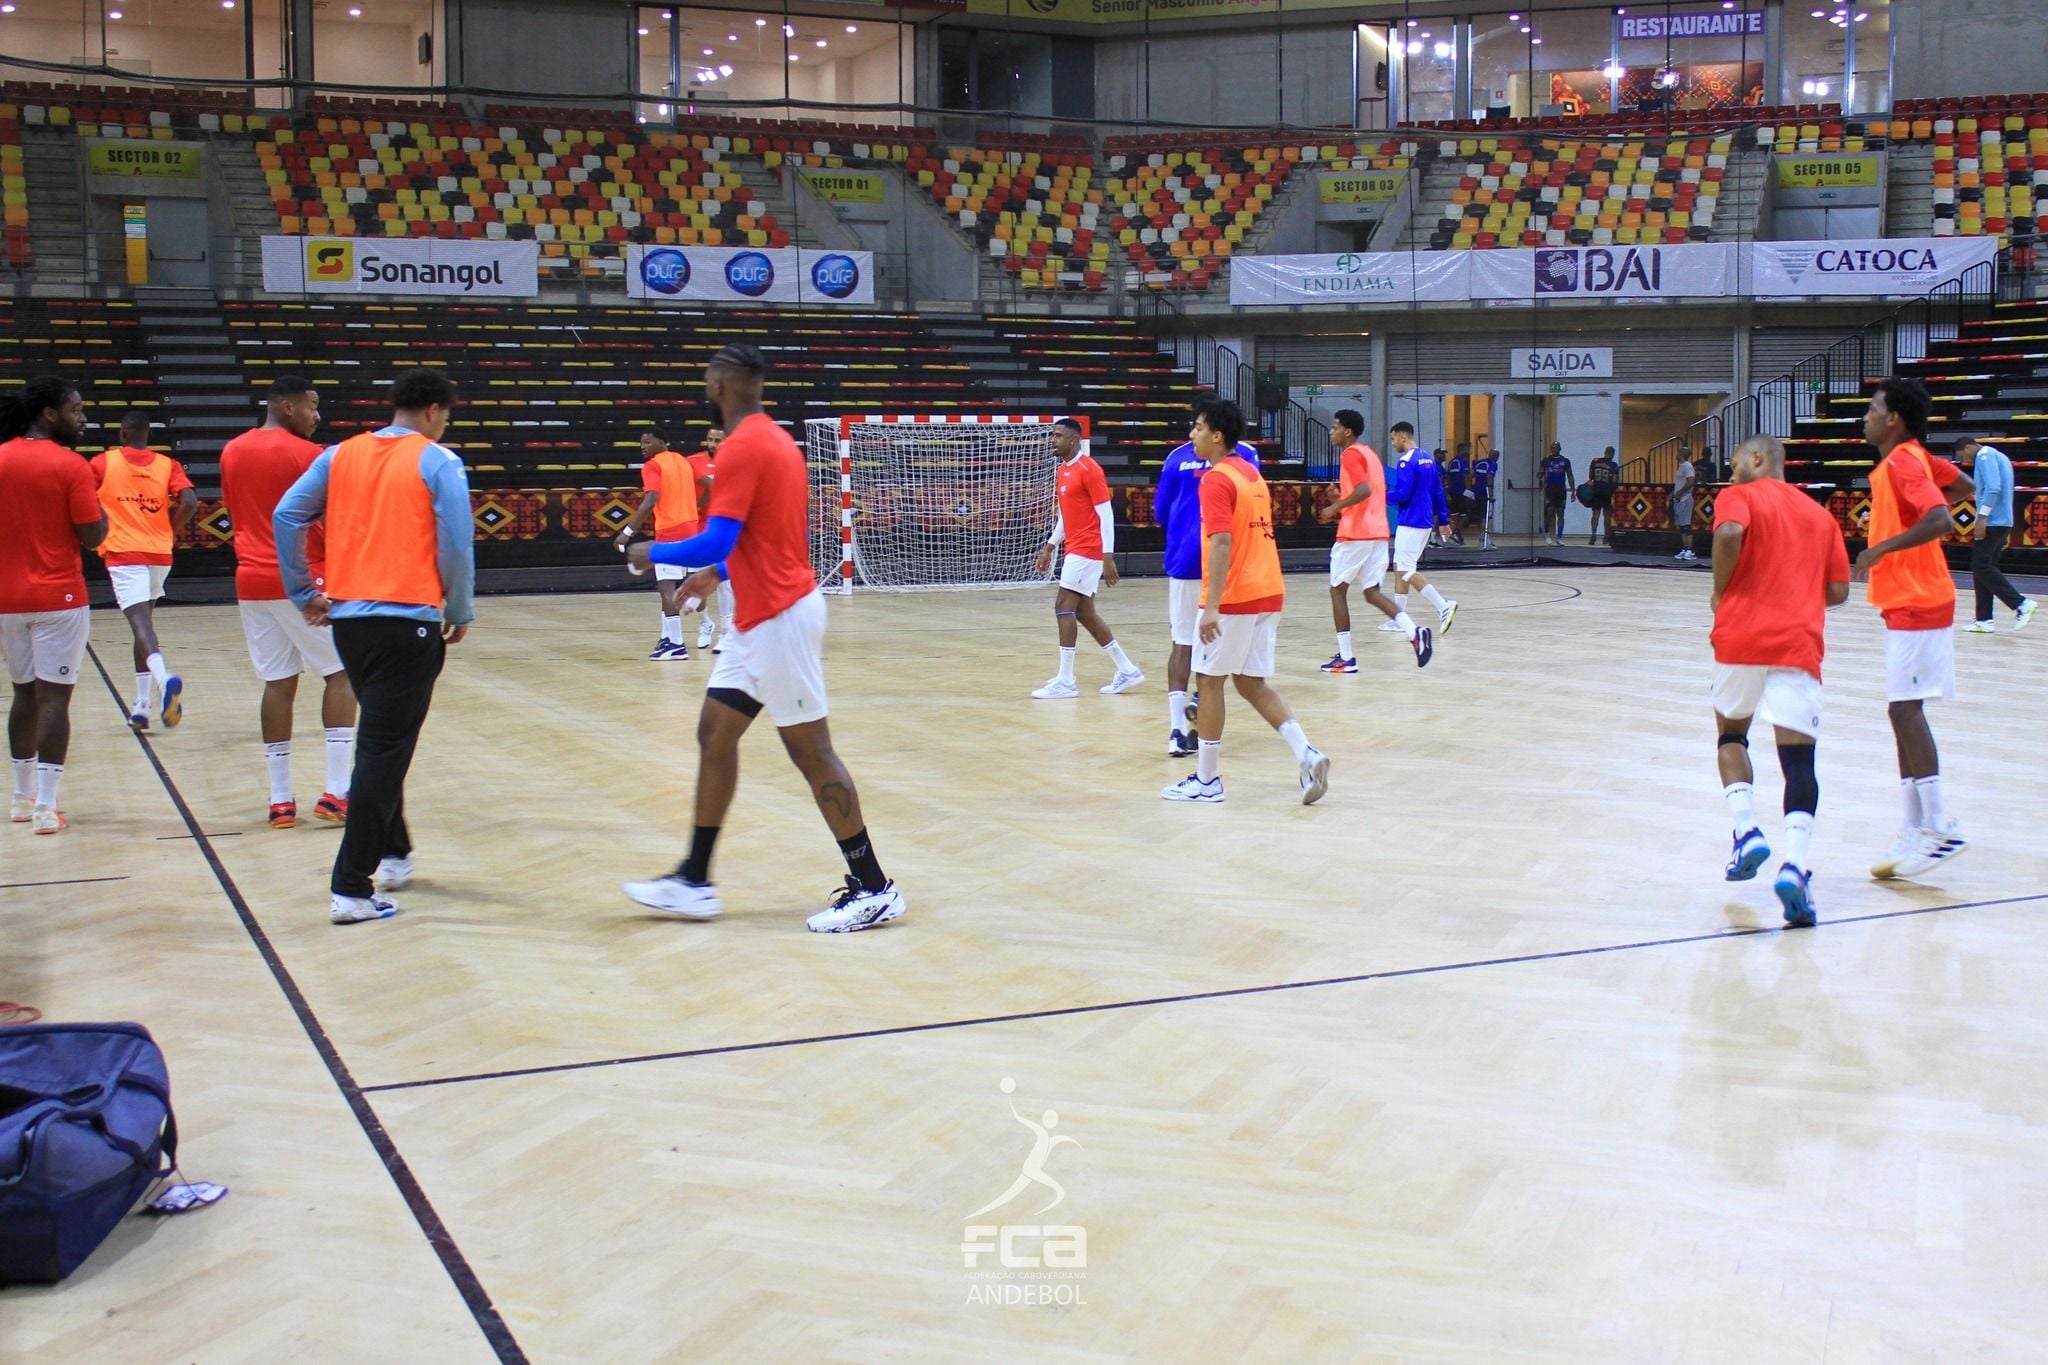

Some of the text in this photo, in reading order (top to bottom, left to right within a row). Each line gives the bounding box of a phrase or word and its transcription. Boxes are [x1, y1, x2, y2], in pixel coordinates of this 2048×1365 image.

[1622, 13, 1761, 37] RESTAURANTE
[108, 150, 182, 164] SECTOR 02
[1794, 163, 1861, 176] SECTOR 05
[811, 177, 869, 190] SECTOR 01
[1334, 180, 1394, 192] SECTOR 03
[1584, 248, 1661, 292] BAI
[1815, 249, 1938, 272] CATOCA
[361, 256, 503, 291] Sonangol
[646, 263, 685, 282] pura
[730, 265, 770, 284] pura
[817, 268, 854, 286] pura
[1303, 276, 1395, 291] ENDIAMA
[1528, 349, 1596, 371] SAÍDA
